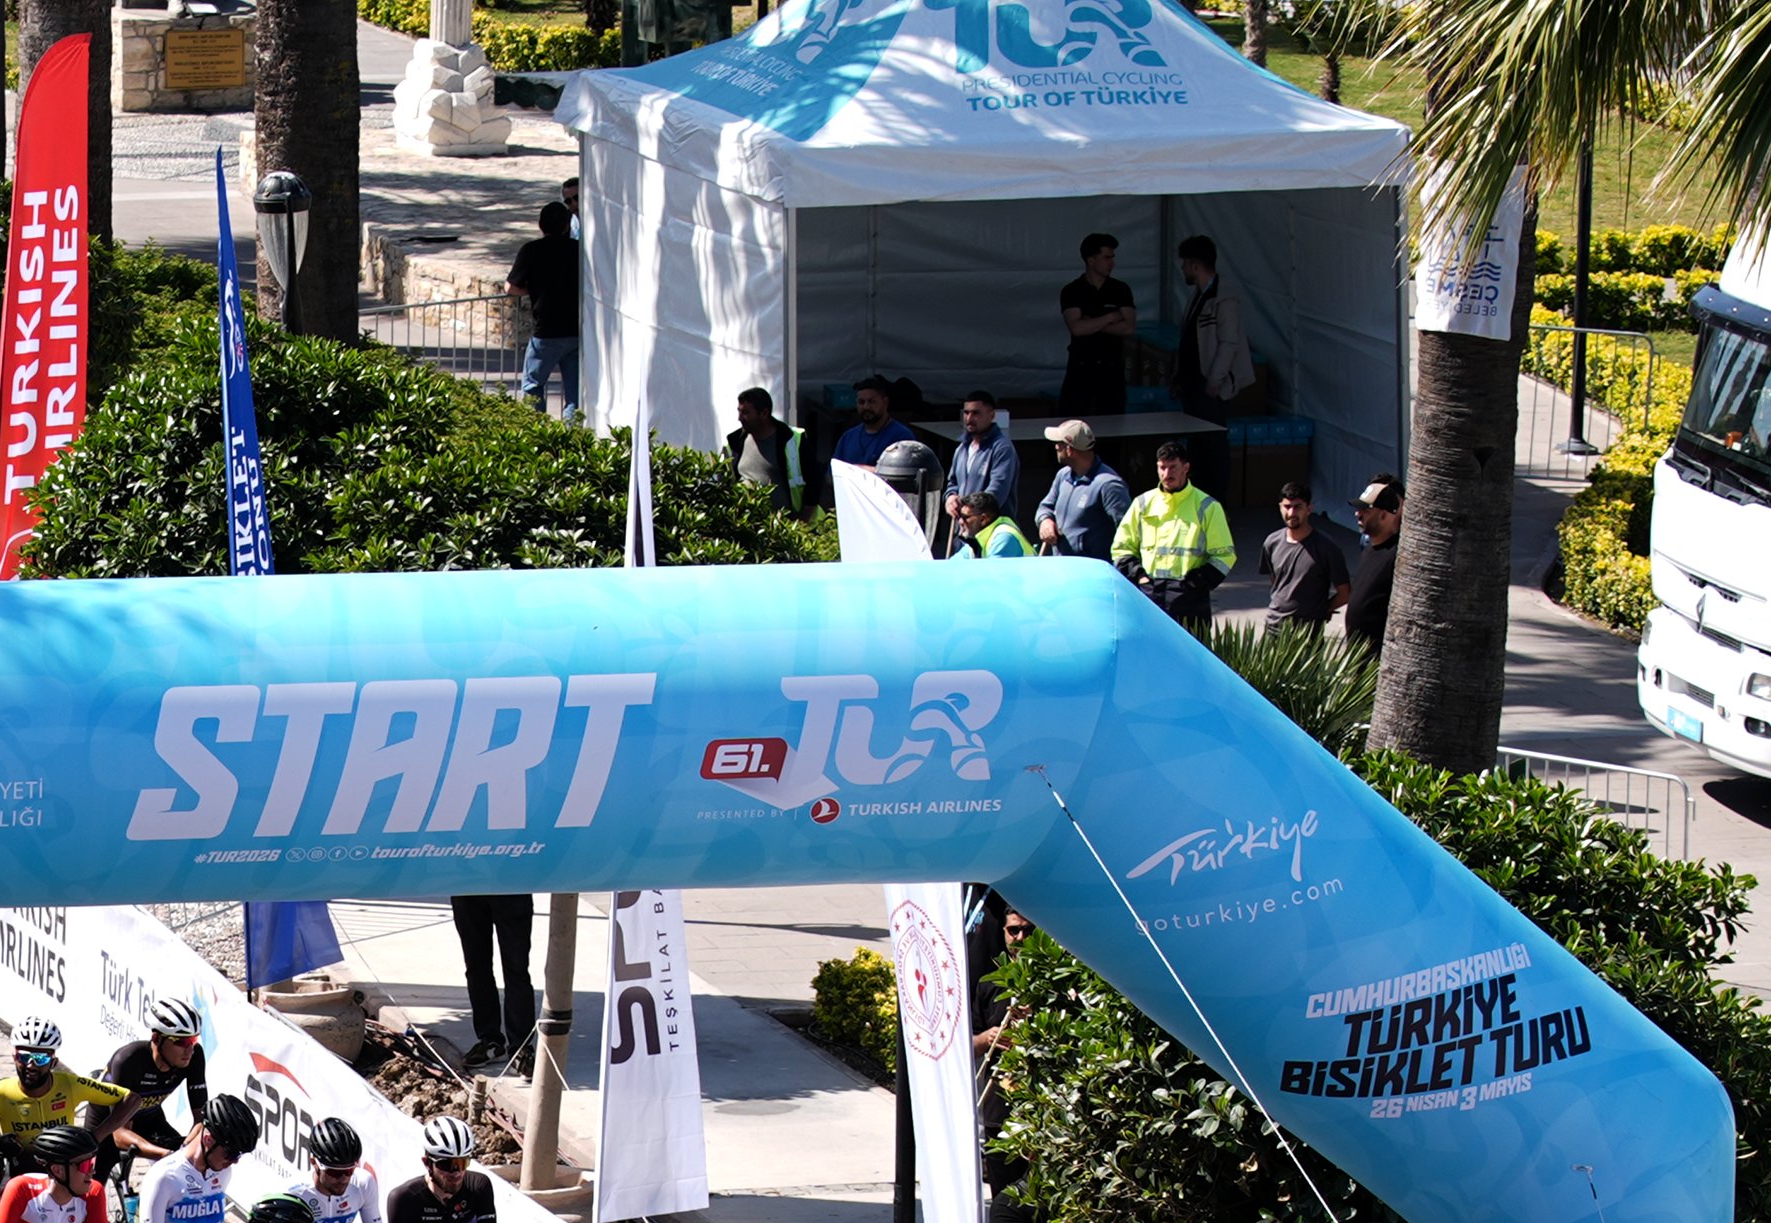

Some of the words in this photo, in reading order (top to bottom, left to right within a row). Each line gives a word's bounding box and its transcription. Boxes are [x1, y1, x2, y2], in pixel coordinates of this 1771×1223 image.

[962, 71, 1098, 92] PRESIDENTIAL
[1101, 69, 1184, 86] CYCLING
[965, 93, 1041, 112] TOUR
[1042, 90, 1079, 107] OF
[1081, 84, 1189, 107] TÜRKİYE
[44, 184, 78, 450] IRLINES
[4, 190, 48, 506] TURKISH
[127, 672, 658, 841] START
[710, 742, 773, 776] 61.
[696, 808, 767, 822] PRESENTED
[769, 808, 787, 819] BY
[848, 801, 923, 818] TURKISH
[925, 798, 1003, 816] AIRLINES
[193, 849, 281, 864] #TUR2026
[370, 841, 546, 860] tourofturkiye.org.tr
[1125, 808, 1319, 887] Türkiye
[1134, 875, 1345, 936] goturkiye.com
[100, 950, 134, 1015] Türk
[1344, 973, 1520, 1057] TÜRKİYE
[1280, 1034, 1483, 1097] BİSİKLET
[1489, 1006, 1592, 1078] TURU
[1370, 1098, 1403, 1119] 26
[1405, 1089, 1459, 1112] NİSAN
[1459, 1087, 1479, 1111] 3
[1479, 1072, 1532, 1102] MAYIS
[172, 1199, 220, 1220] MUĞLA
